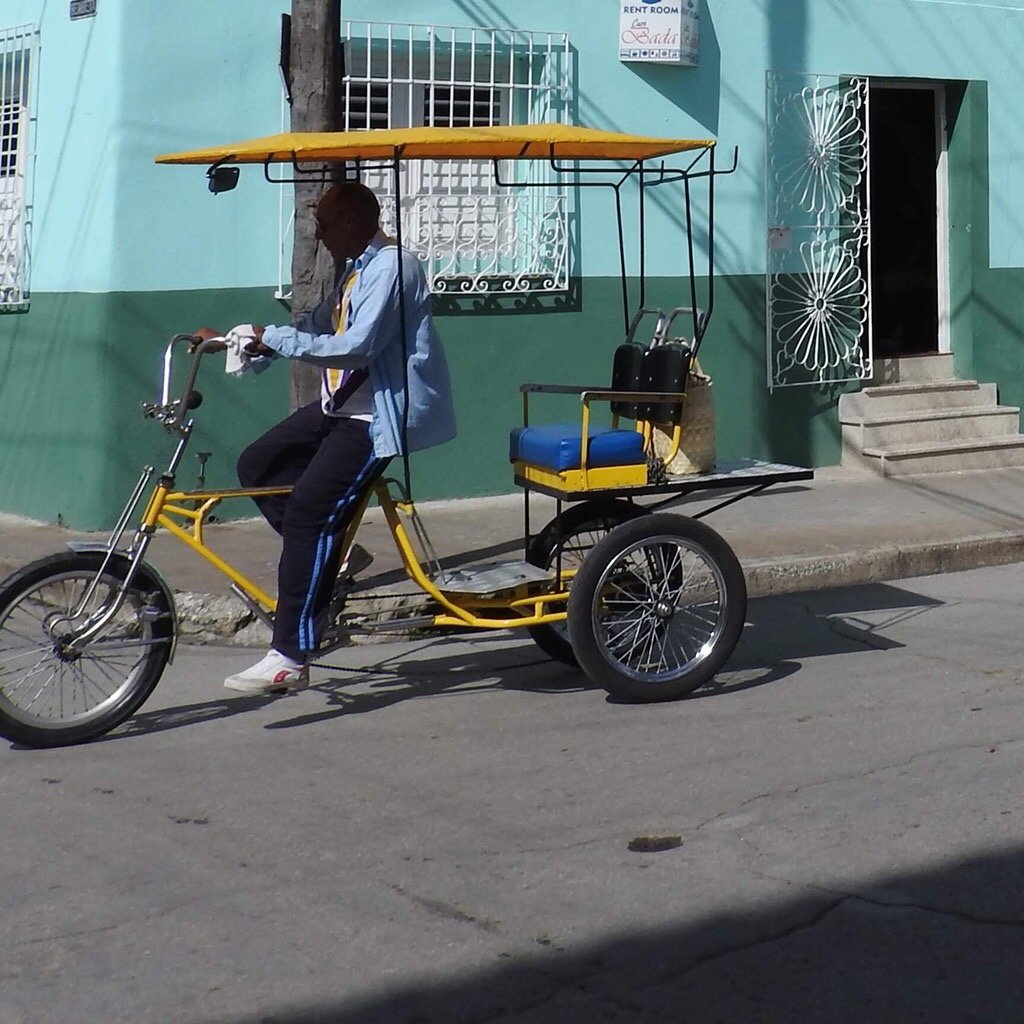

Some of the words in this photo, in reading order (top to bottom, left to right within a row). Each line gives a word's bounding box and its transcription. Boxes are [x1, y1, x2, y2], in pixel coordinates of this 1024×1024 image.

[624, 6, 648, 14] RENT
[650, 6, 679, 14] ROOM
[621, 26, 679, 45] Bada
